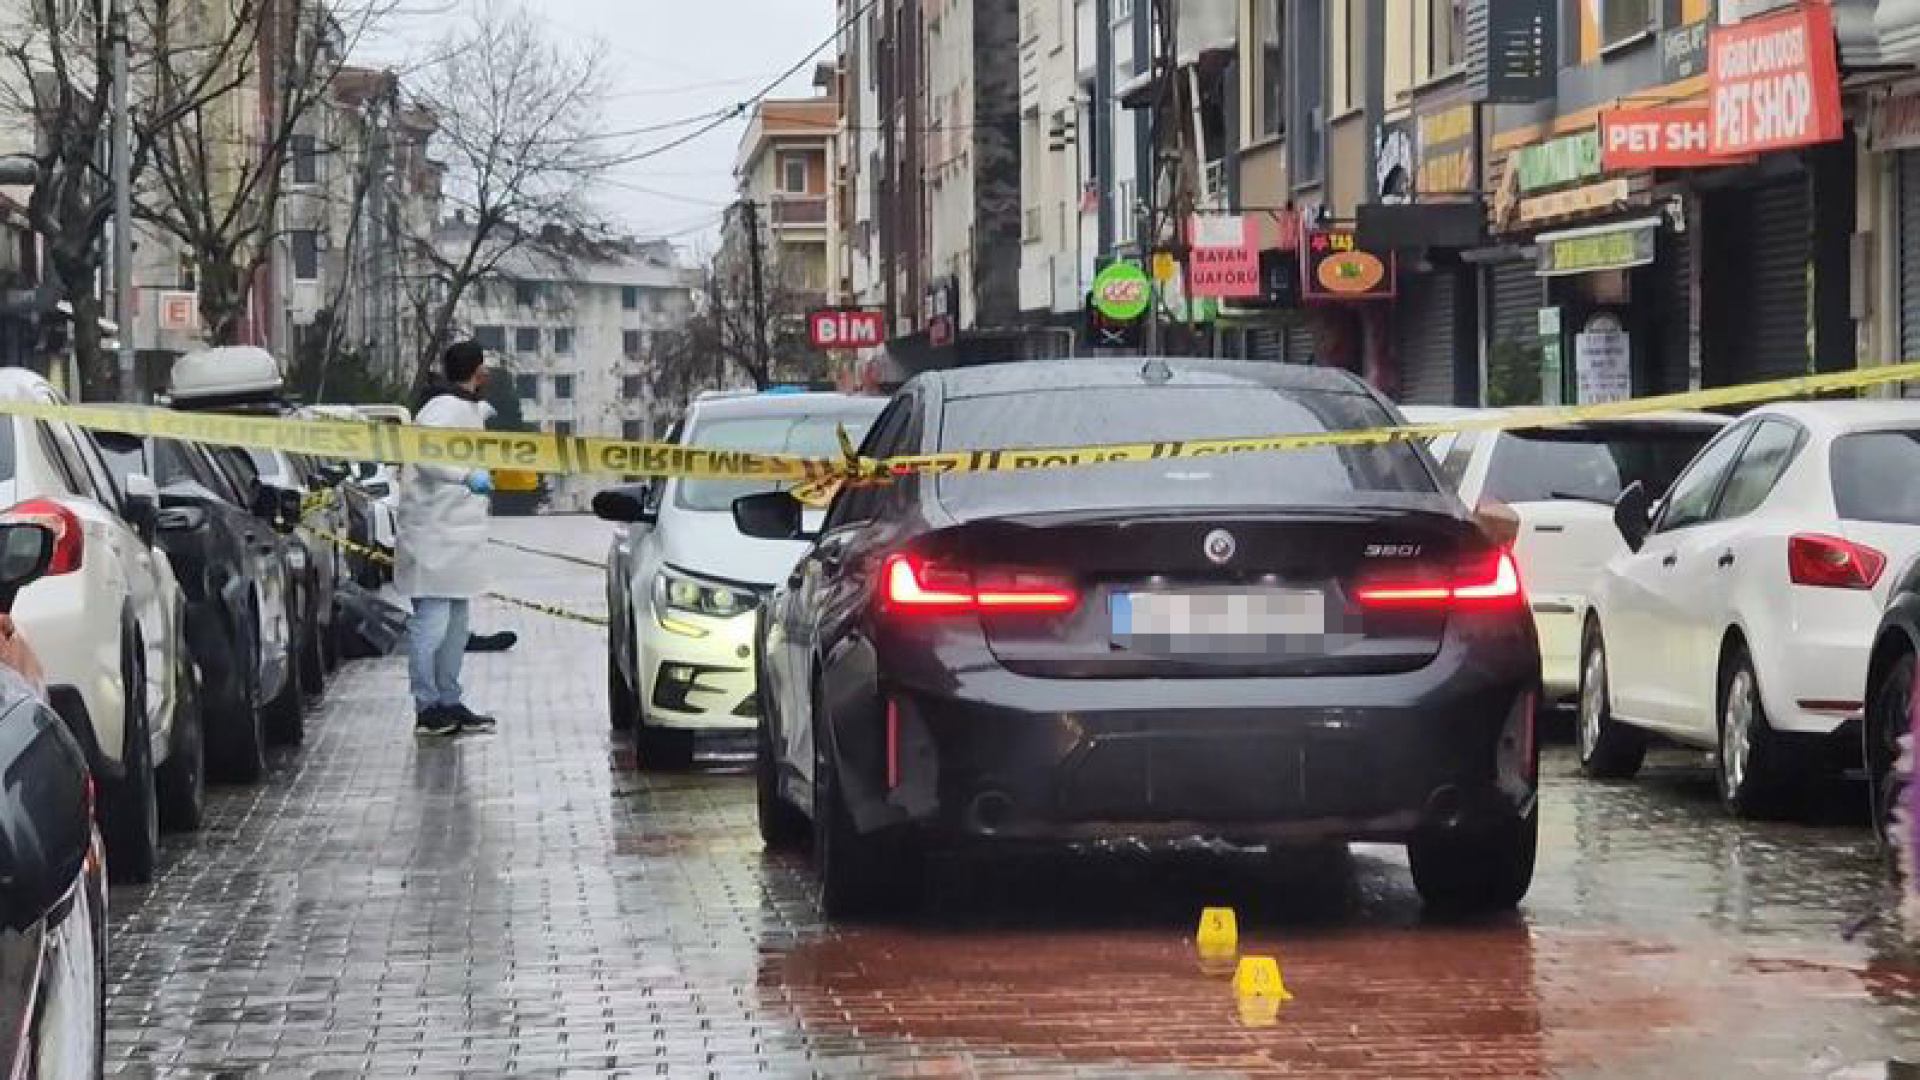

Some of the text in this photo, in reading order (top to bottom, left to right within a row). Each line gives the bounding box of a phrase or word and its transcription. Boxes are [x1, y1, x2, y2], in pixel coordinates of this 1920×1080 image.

[1716, 82, 1748, 148] PET
[1752, 71, 1811, 142] SHOP
[1609, 119, 1707, 152] PET SH
[1196, 250, 1247, 262] BAYAN
[1193, 268, 1258, 284] UAFÖRÜ
[817, 312, 877, 343] BİM
